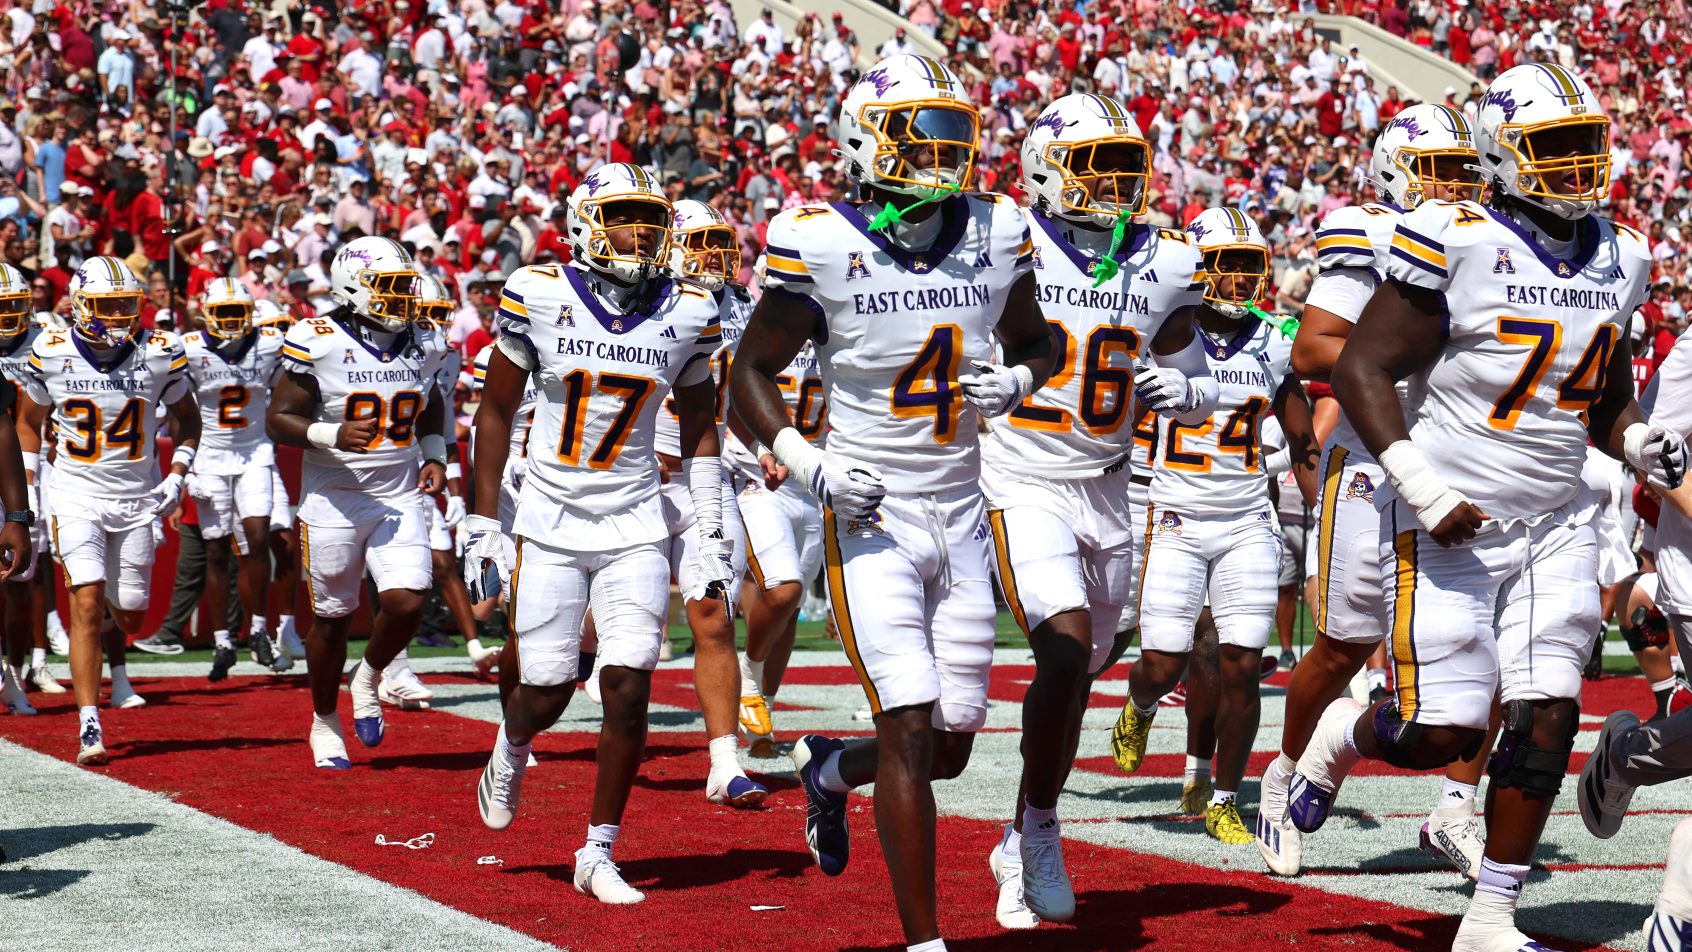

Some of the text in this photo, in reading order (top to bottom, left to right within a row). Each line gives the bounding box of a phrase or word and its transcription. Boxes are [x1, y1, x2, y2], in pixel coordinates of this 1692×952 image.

[1571, 106, 1587, 114] ECU
[853, 284, 991, 315] EAST CAROLINA
[1034, 284, 1149, 316] AST CAROLINA
[1507, 285, 1621, 312] EAST CAROLINA
[557, 337, 669, 368] EAST CAROLINA
[66, 379, 144, 392] EAST CAROLINA
[203, 371, 223, 381] EAST
[348, 369, 422, 384] EAST CAROLINA
[890, 323, 963, 446] 4
[1008, 319, 1142, 437] 26
[1212, 370, 1267, 387] AROLINA
[1488, 316, 1617, 431] 74
[217, 384, 250, 429] 2
[343, 390, 425, 451] 98
[556, 367, 657, 471] 17
[63, 397, 146, 464] 34
[1164, 396, 1270, 474] 24
